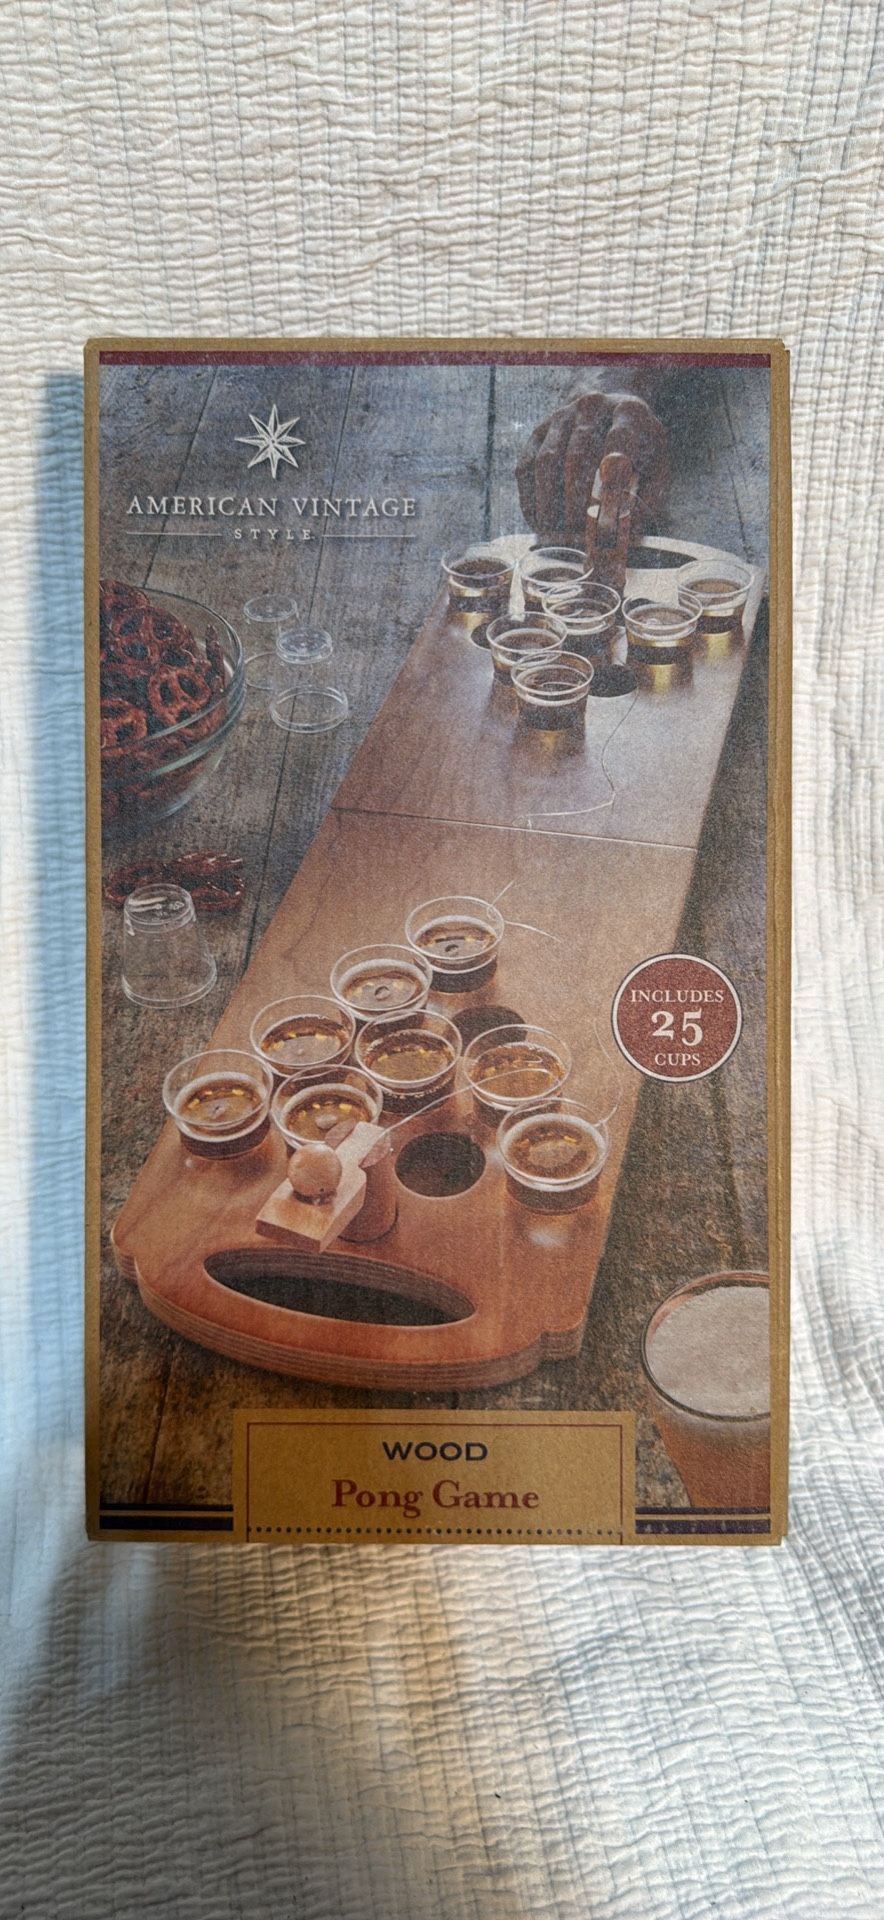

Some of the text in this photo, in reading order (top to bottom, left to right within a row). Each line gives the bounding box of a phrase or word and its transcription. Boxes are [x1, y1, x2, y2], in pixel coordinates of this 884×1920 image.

[126, 496, 416, 517] AMERICAN VINTAGE
[234, 528, 312, 541] STYLE
[631, 990, 724, 1003] INCLUDES
[651, 1008, 703, 1046] 25
[655, 1053, 701, 1066] CUPS
[382, 1442, 488, 1461] WOOD
[332, 1479, 540, 1518] Pong Game
